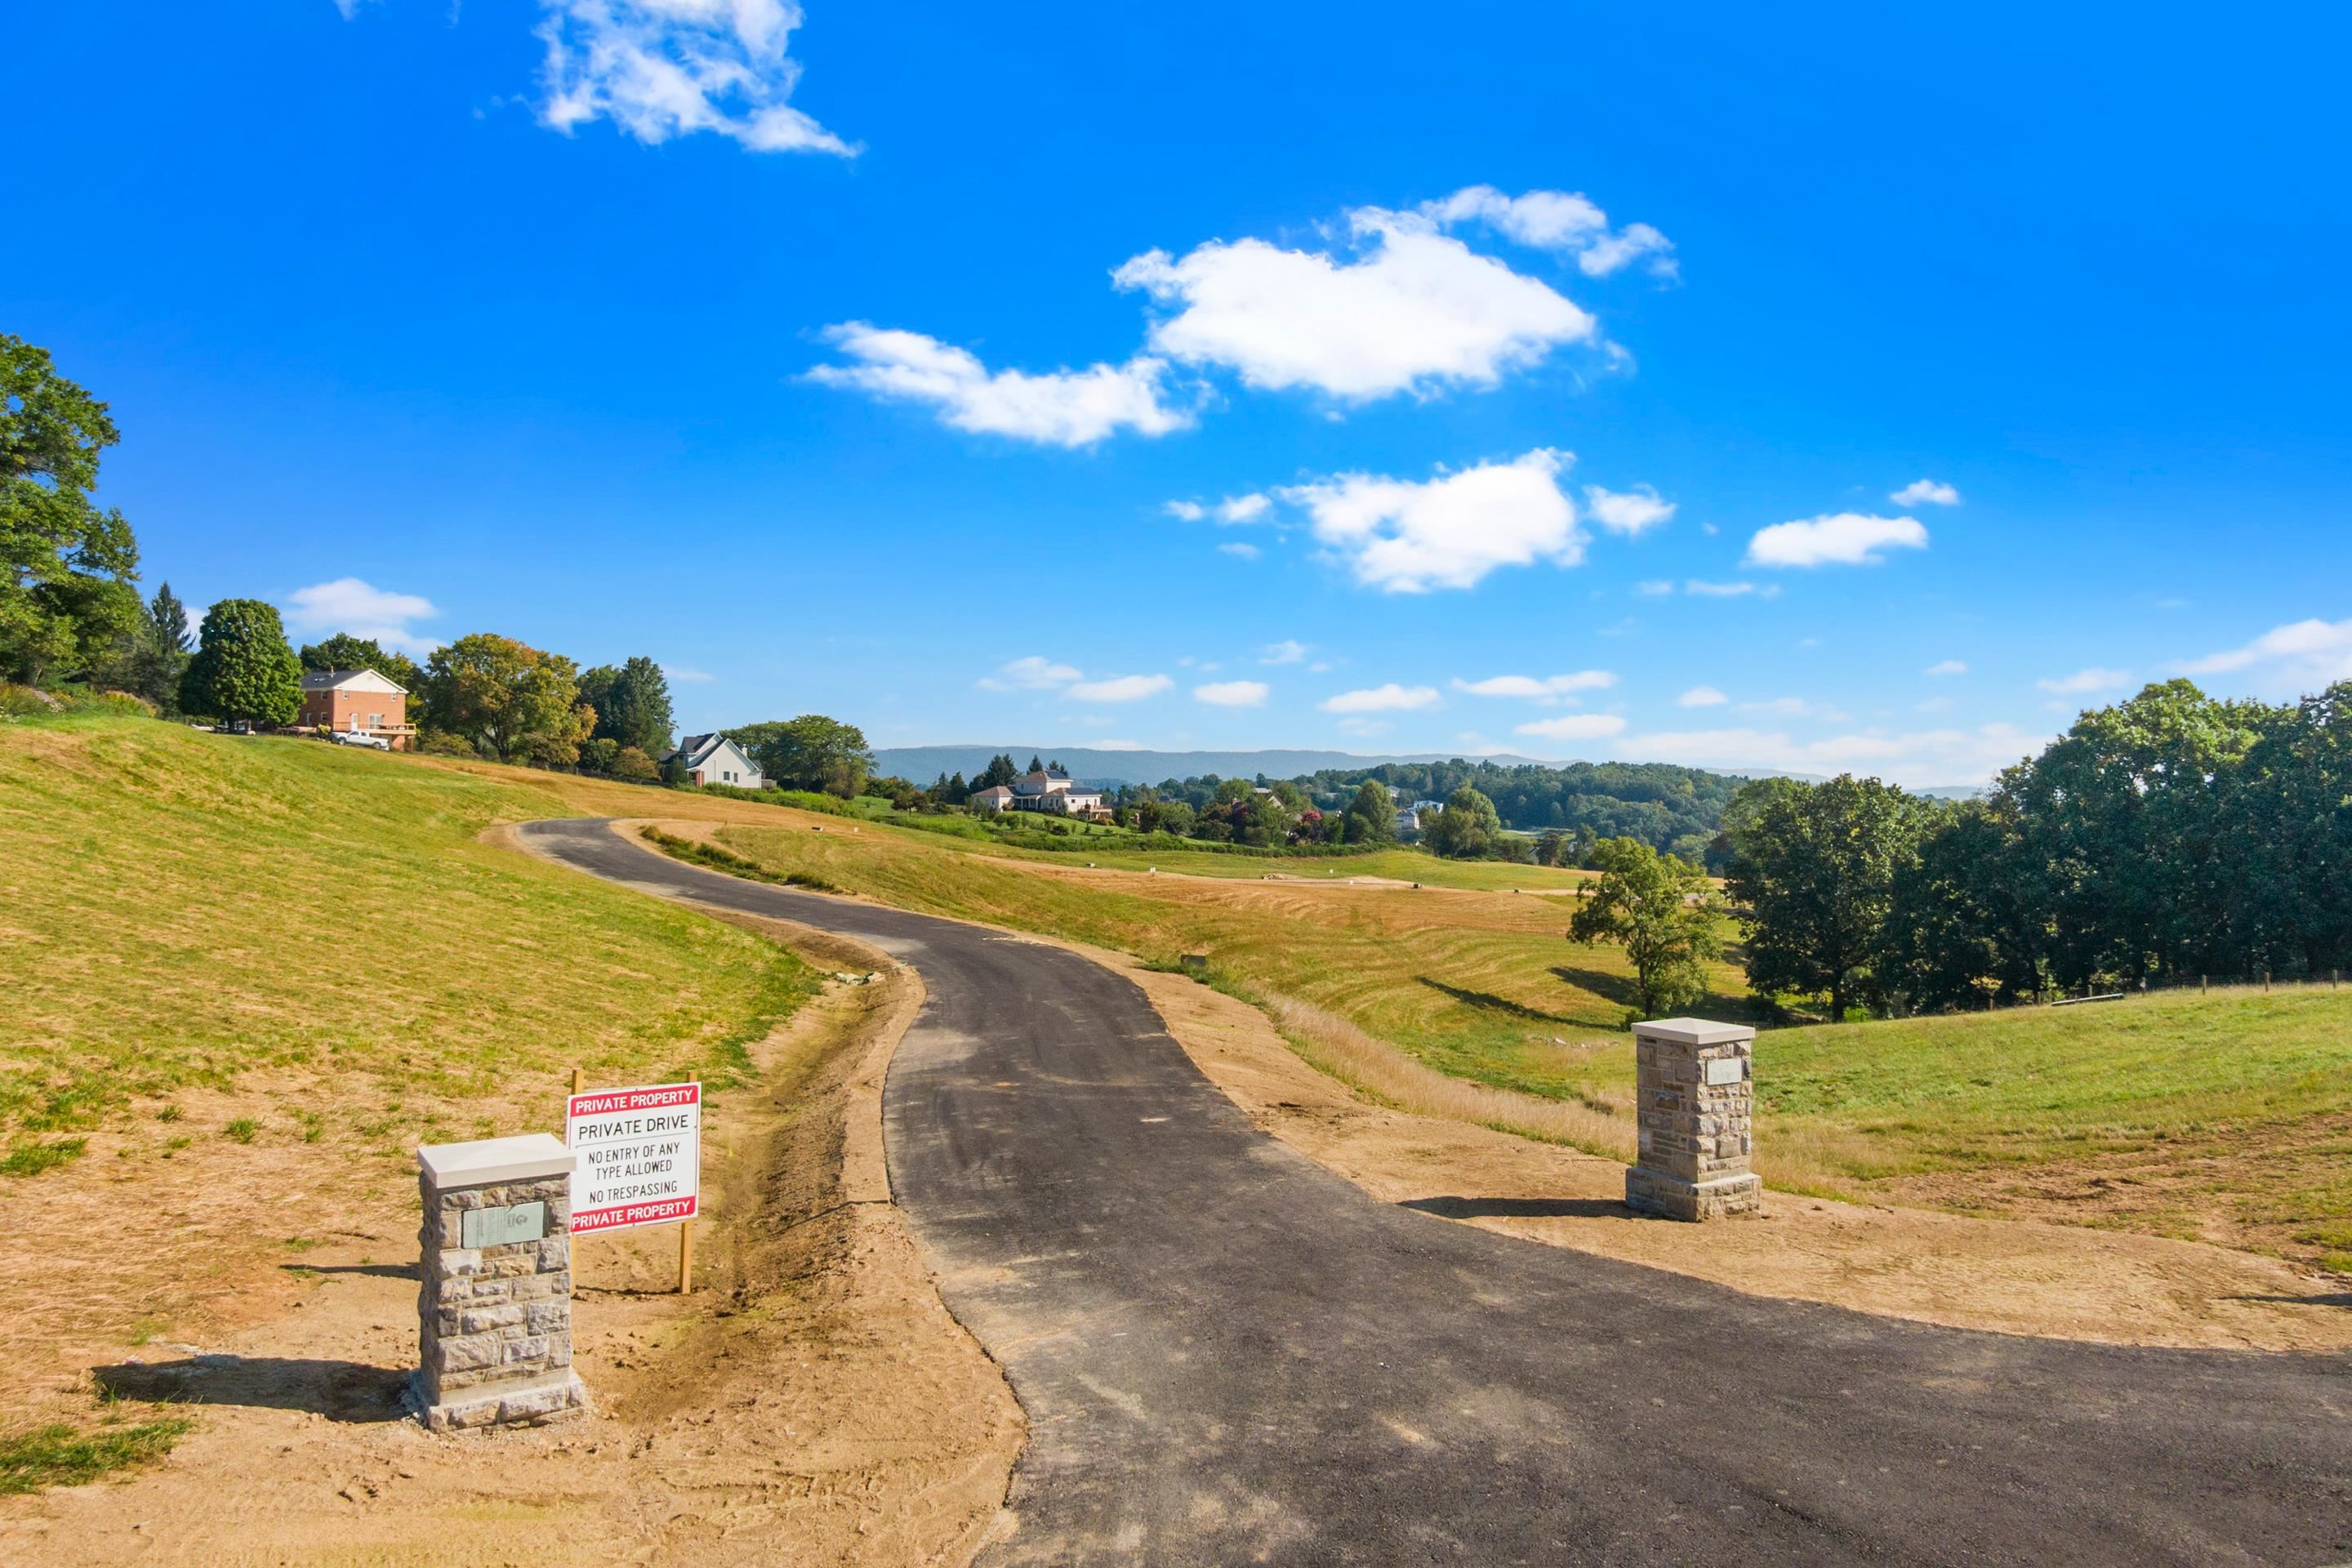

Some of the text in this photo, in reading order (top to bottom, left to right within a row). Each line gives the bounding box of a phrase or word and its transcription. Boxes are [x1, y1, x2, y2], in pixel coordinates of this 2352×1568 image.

[576, 1089, 693, 1113] PRIVATE PROPERTY
[579, 1115, 688, 1140] PRIVATE DRIVE
[589, 1142, 680, 1165] NO ENTRY OF ANY
[596, 1160, 672, 1180] TYPE ALLOWED
[590, 1181, 678, 1204] NO TRESPASSING
[572, 1200, 690, 1229] PRIVATE PROPERTY
